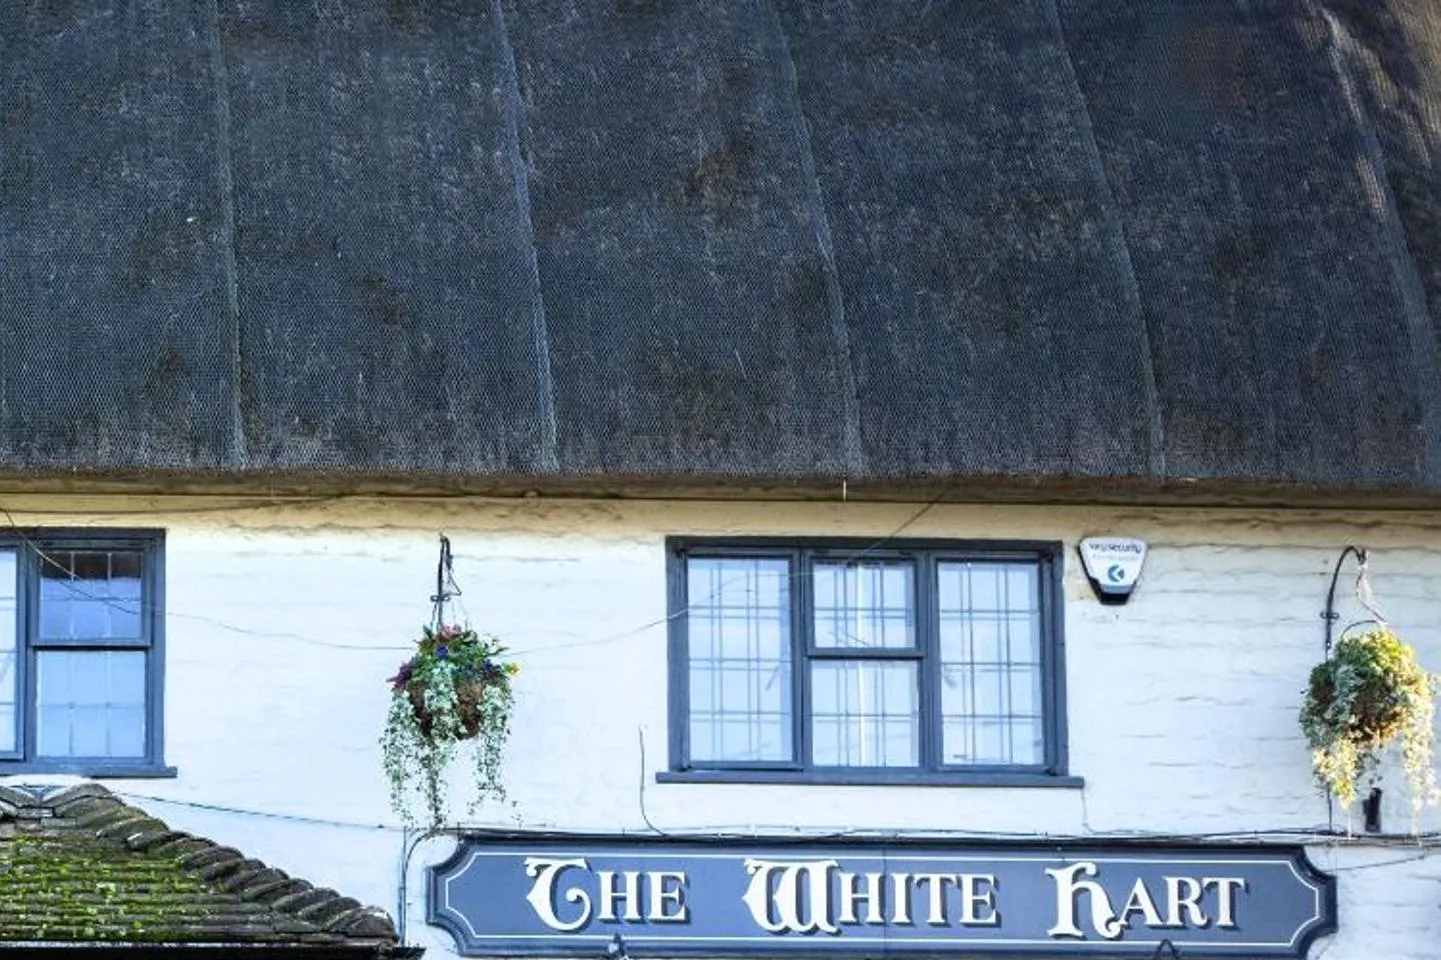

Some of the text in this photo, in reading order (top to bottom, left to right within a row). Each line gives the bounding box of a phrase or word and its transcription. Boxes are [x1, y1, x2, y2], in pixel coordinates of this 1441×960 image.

[524, 856, 1245, 938] THE WHITE HART
